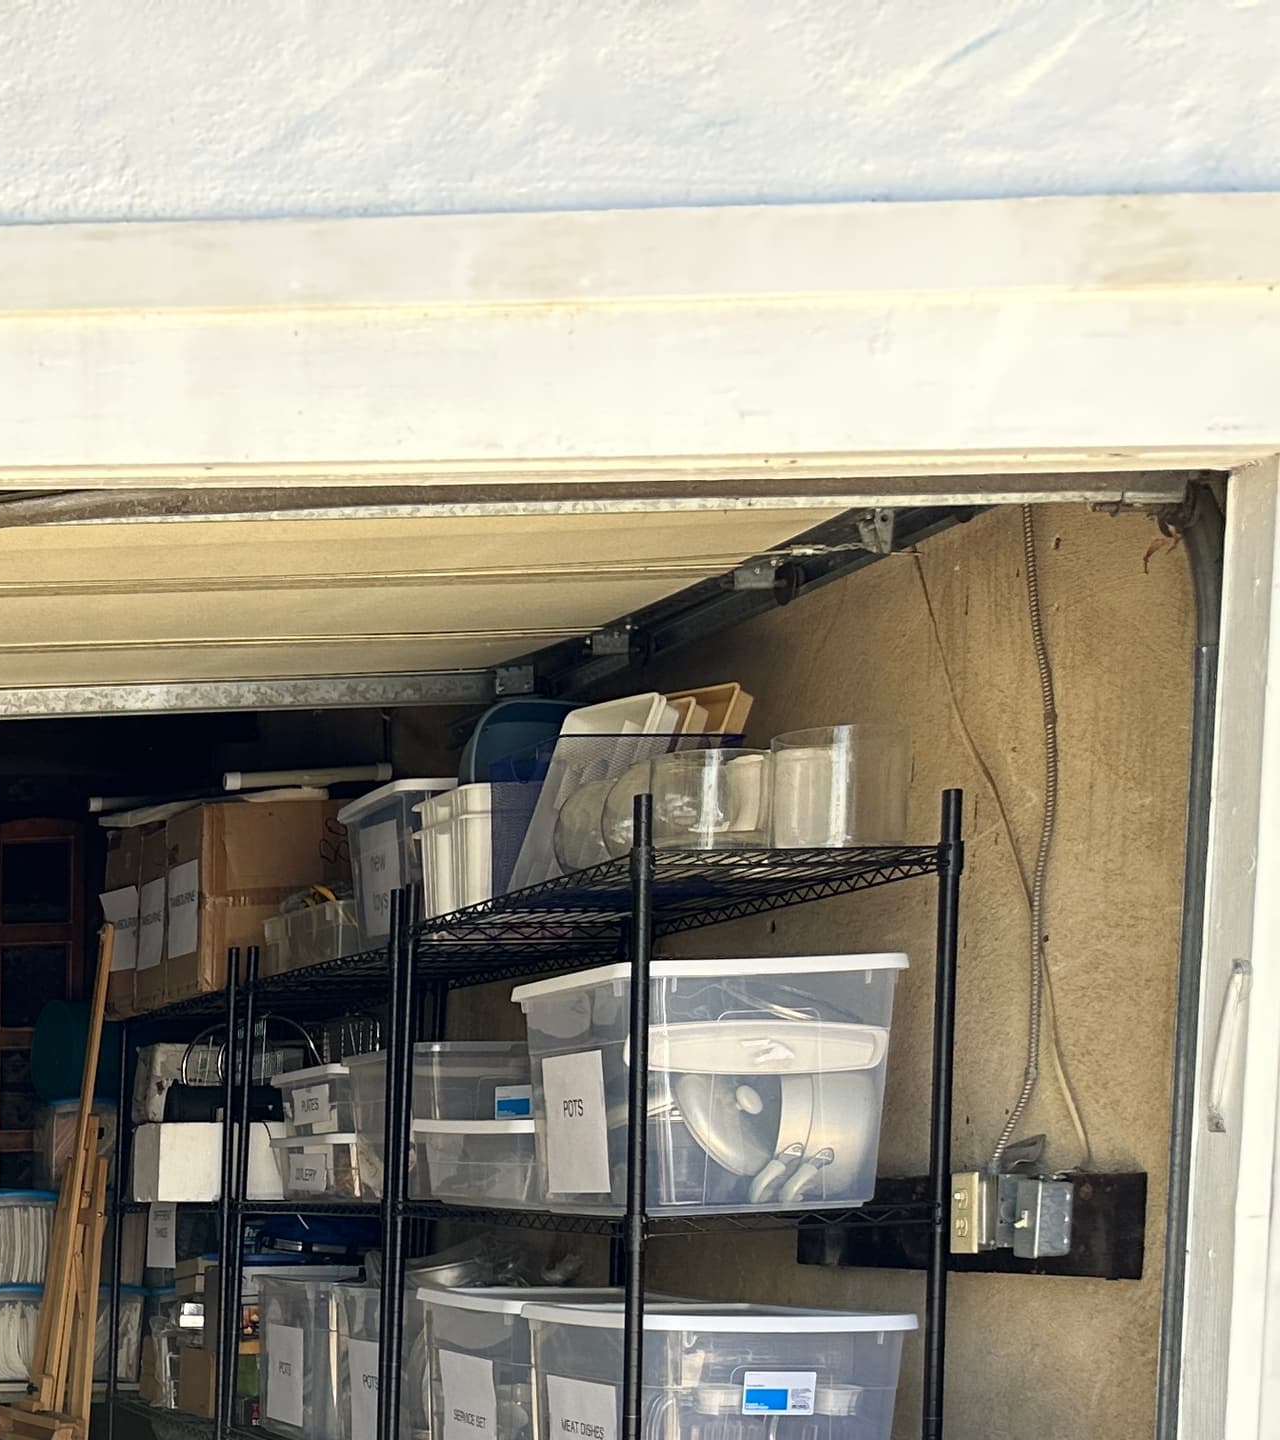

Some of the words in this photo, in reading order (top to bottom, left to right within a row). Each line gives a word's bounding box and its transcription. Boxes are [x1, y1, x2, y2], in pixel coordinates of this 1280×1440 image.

[563, 1098, 584, 1117] POTS
[561, 1417, 579, 1434] MEAT
[580, 1423, 605, 1440] DISHES
